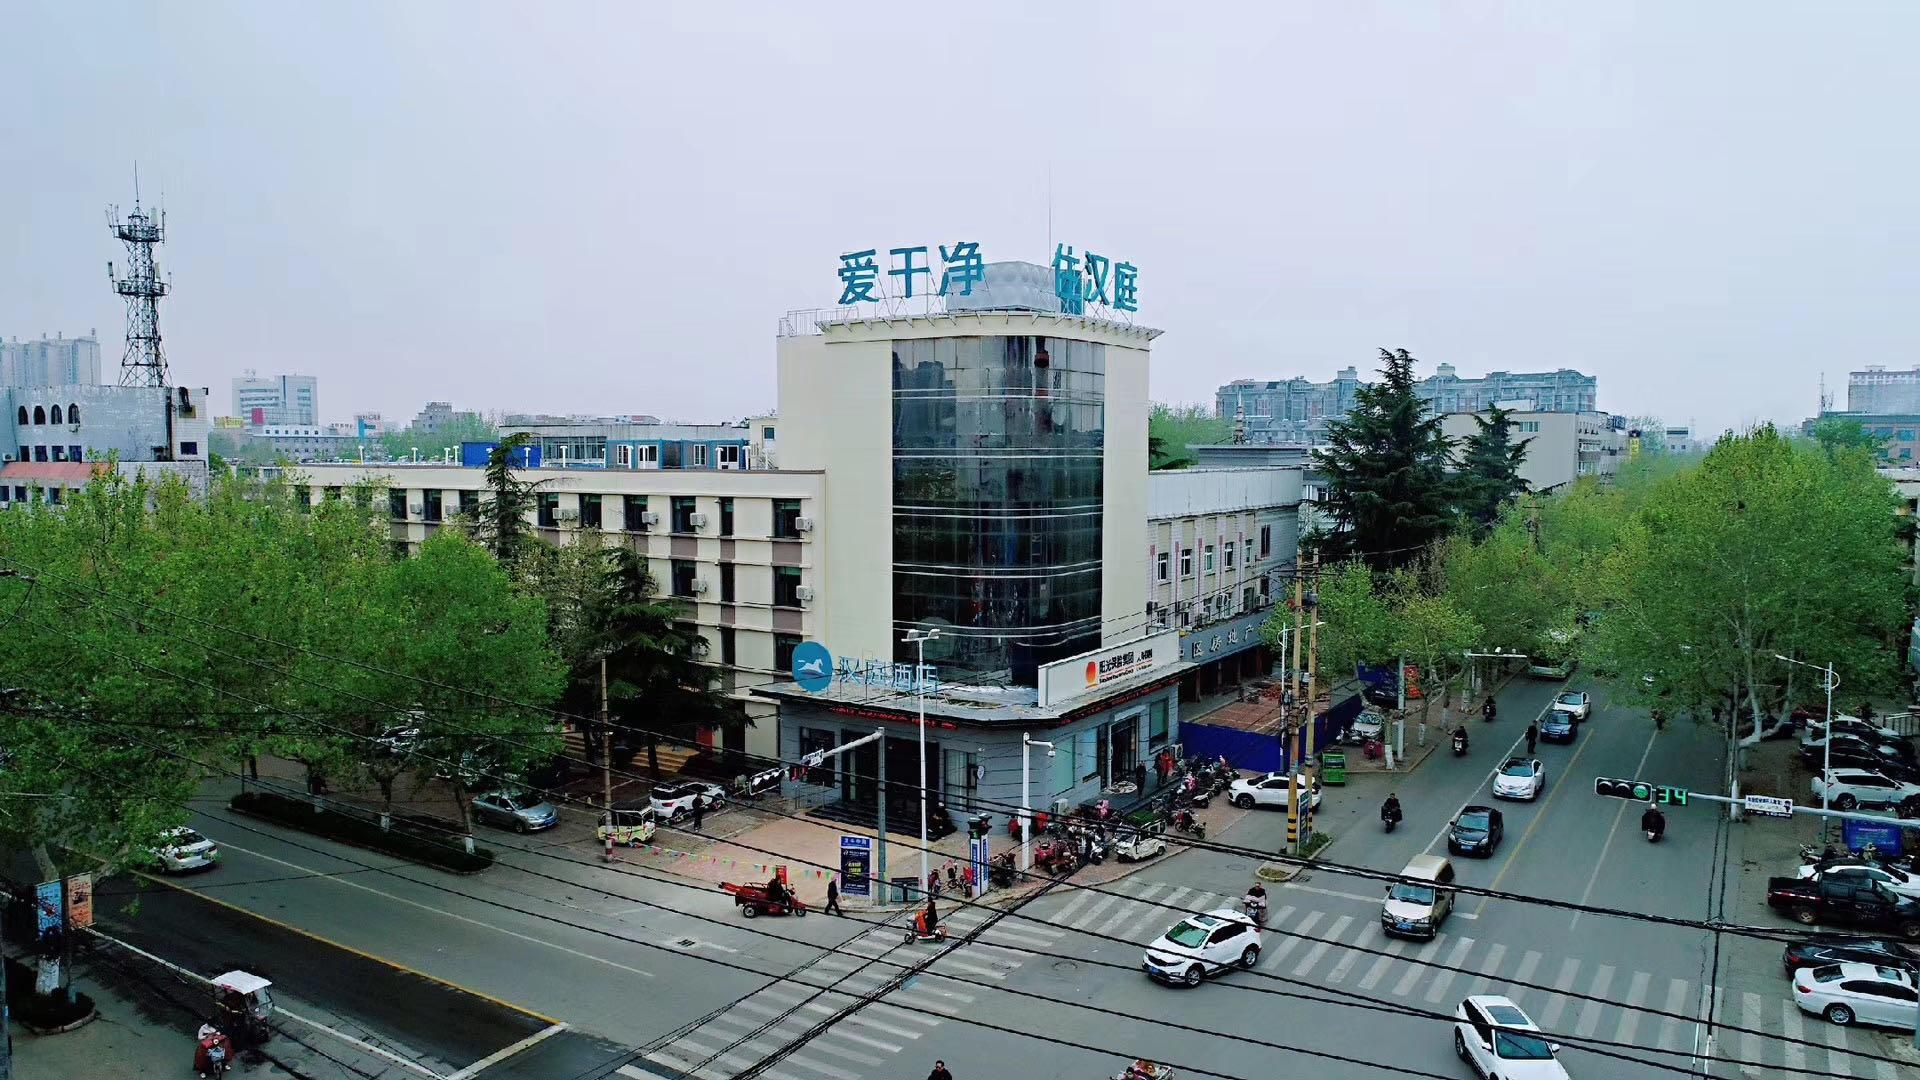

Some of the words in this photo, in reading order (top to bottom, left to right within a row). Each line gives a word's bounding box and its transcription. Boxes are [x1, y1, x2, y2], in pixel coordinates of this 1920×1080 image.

[838, 241, 983, 304] 爱干净
[1658, 787, 1686, 805] 34
